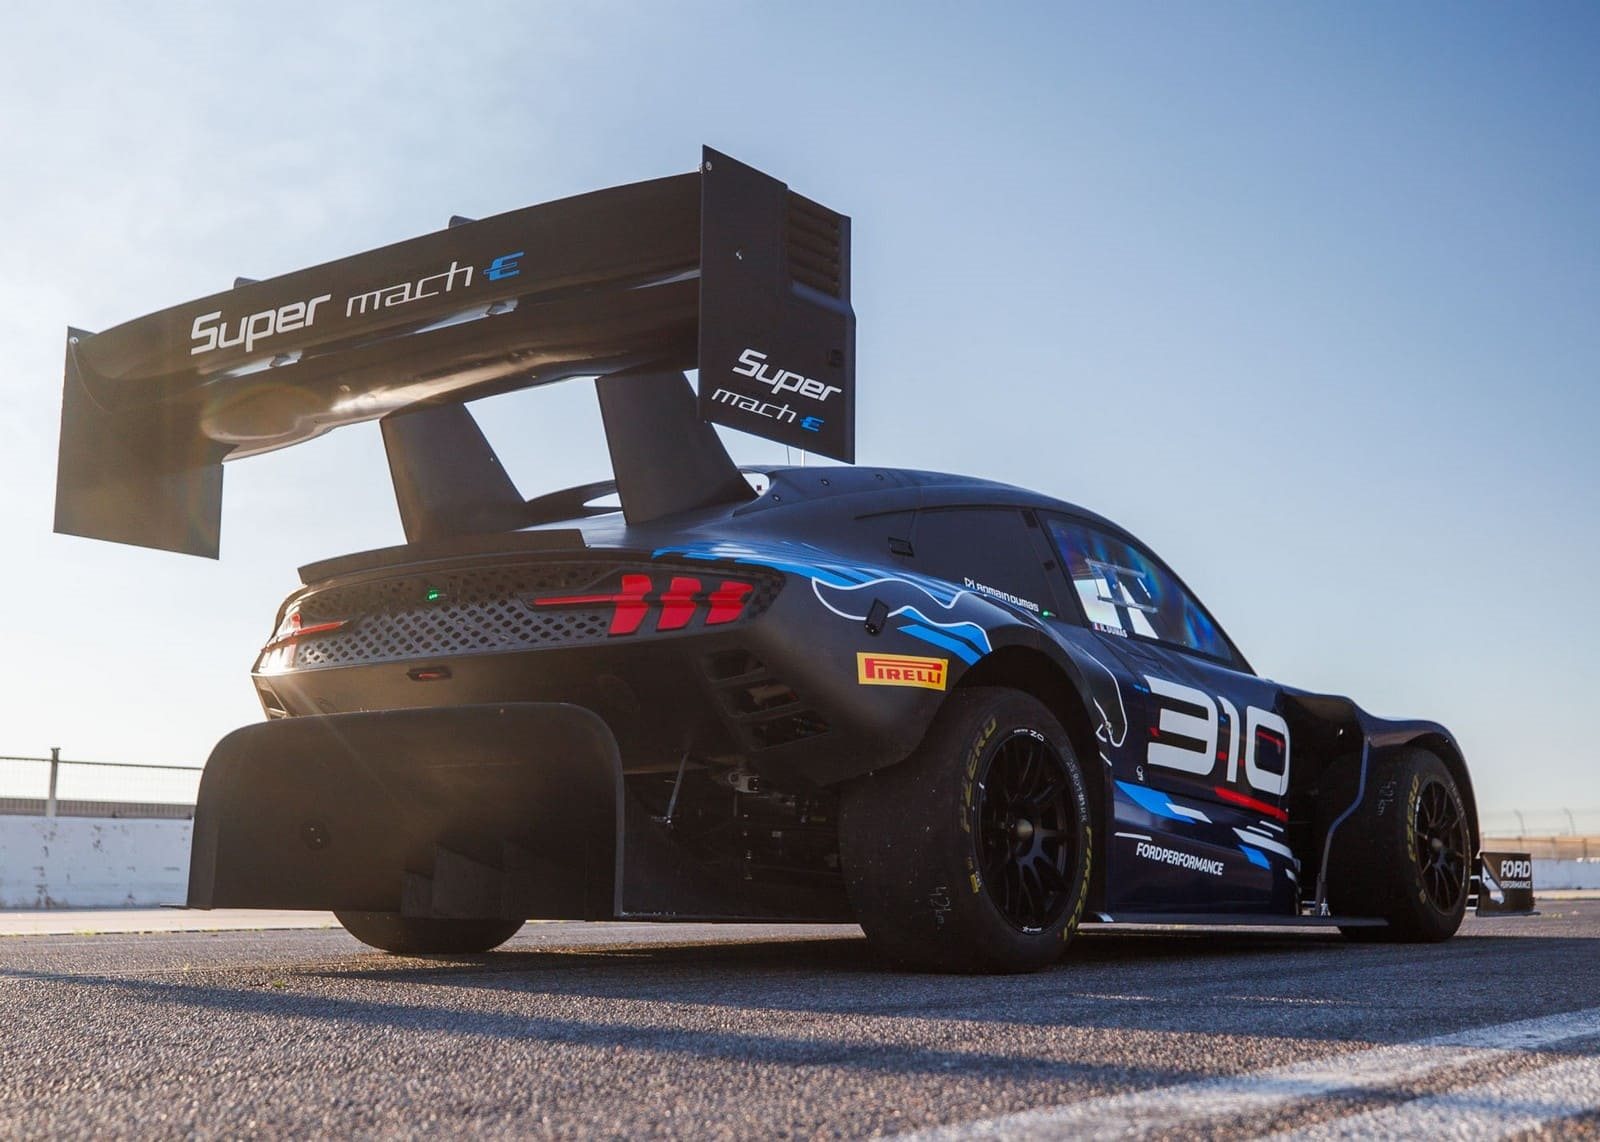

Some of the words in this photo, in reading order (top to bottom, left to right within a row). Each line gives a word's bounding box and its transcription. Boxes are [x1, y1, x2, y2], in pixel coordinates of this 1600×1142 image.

[190, 294, 332, 355] Super
[346, 261, 474, 317] mach
[483, 251, 525, 281] E
[732, 348, 842, 401] Super
[711, 388, 797, 423] mach
[800, 415, 825, 432] E
[864, 657, 942, 684] PIRELLI
[1144, 675, 1290, 796] 310
[1136, 842, 1162, 861] FORD
[1162, 849, 1225, 876] PERFORMANCE
[1500, 860, 1531, 878] FORD
